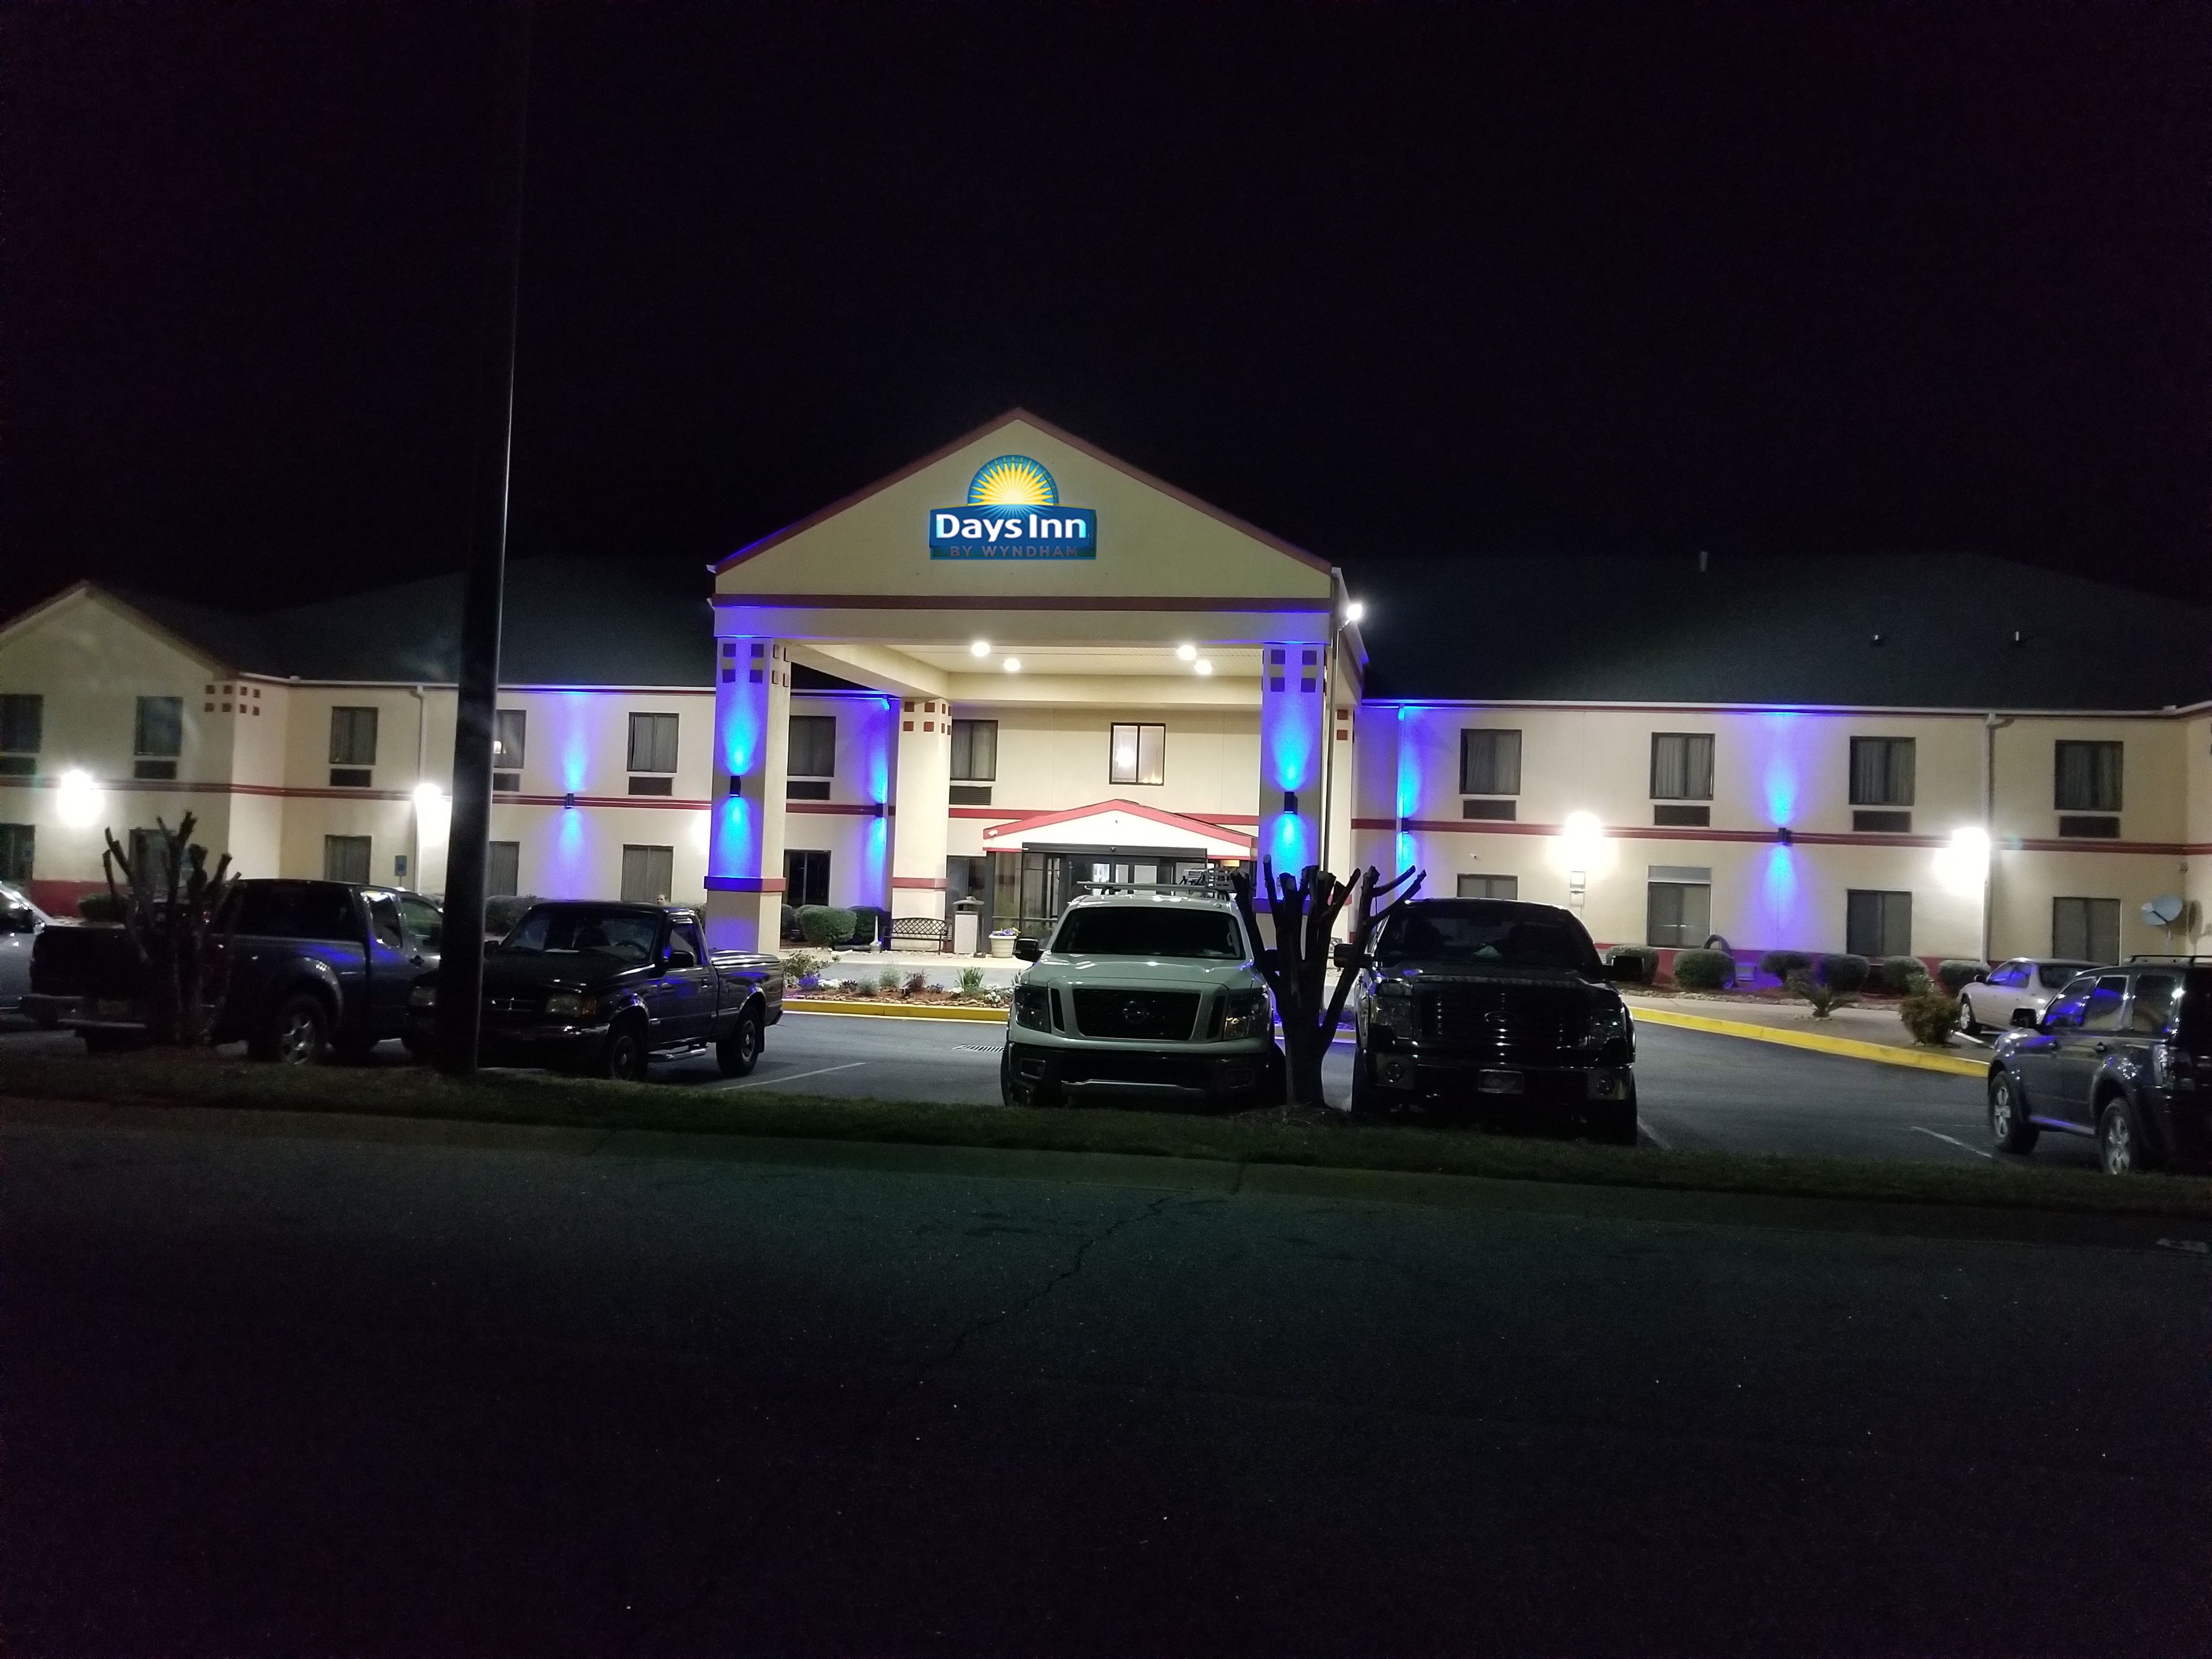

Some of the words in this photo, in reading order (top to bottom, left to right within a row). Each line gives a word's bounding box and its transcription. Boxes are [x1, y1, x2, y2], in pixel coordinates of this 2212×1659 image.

[936, 514, 1022, 542] Days
[1029, 514, 1086, 538] Inn
[950, 546, 973, 557] BY
[982, 546, 1078, 557] WYNDHAM
